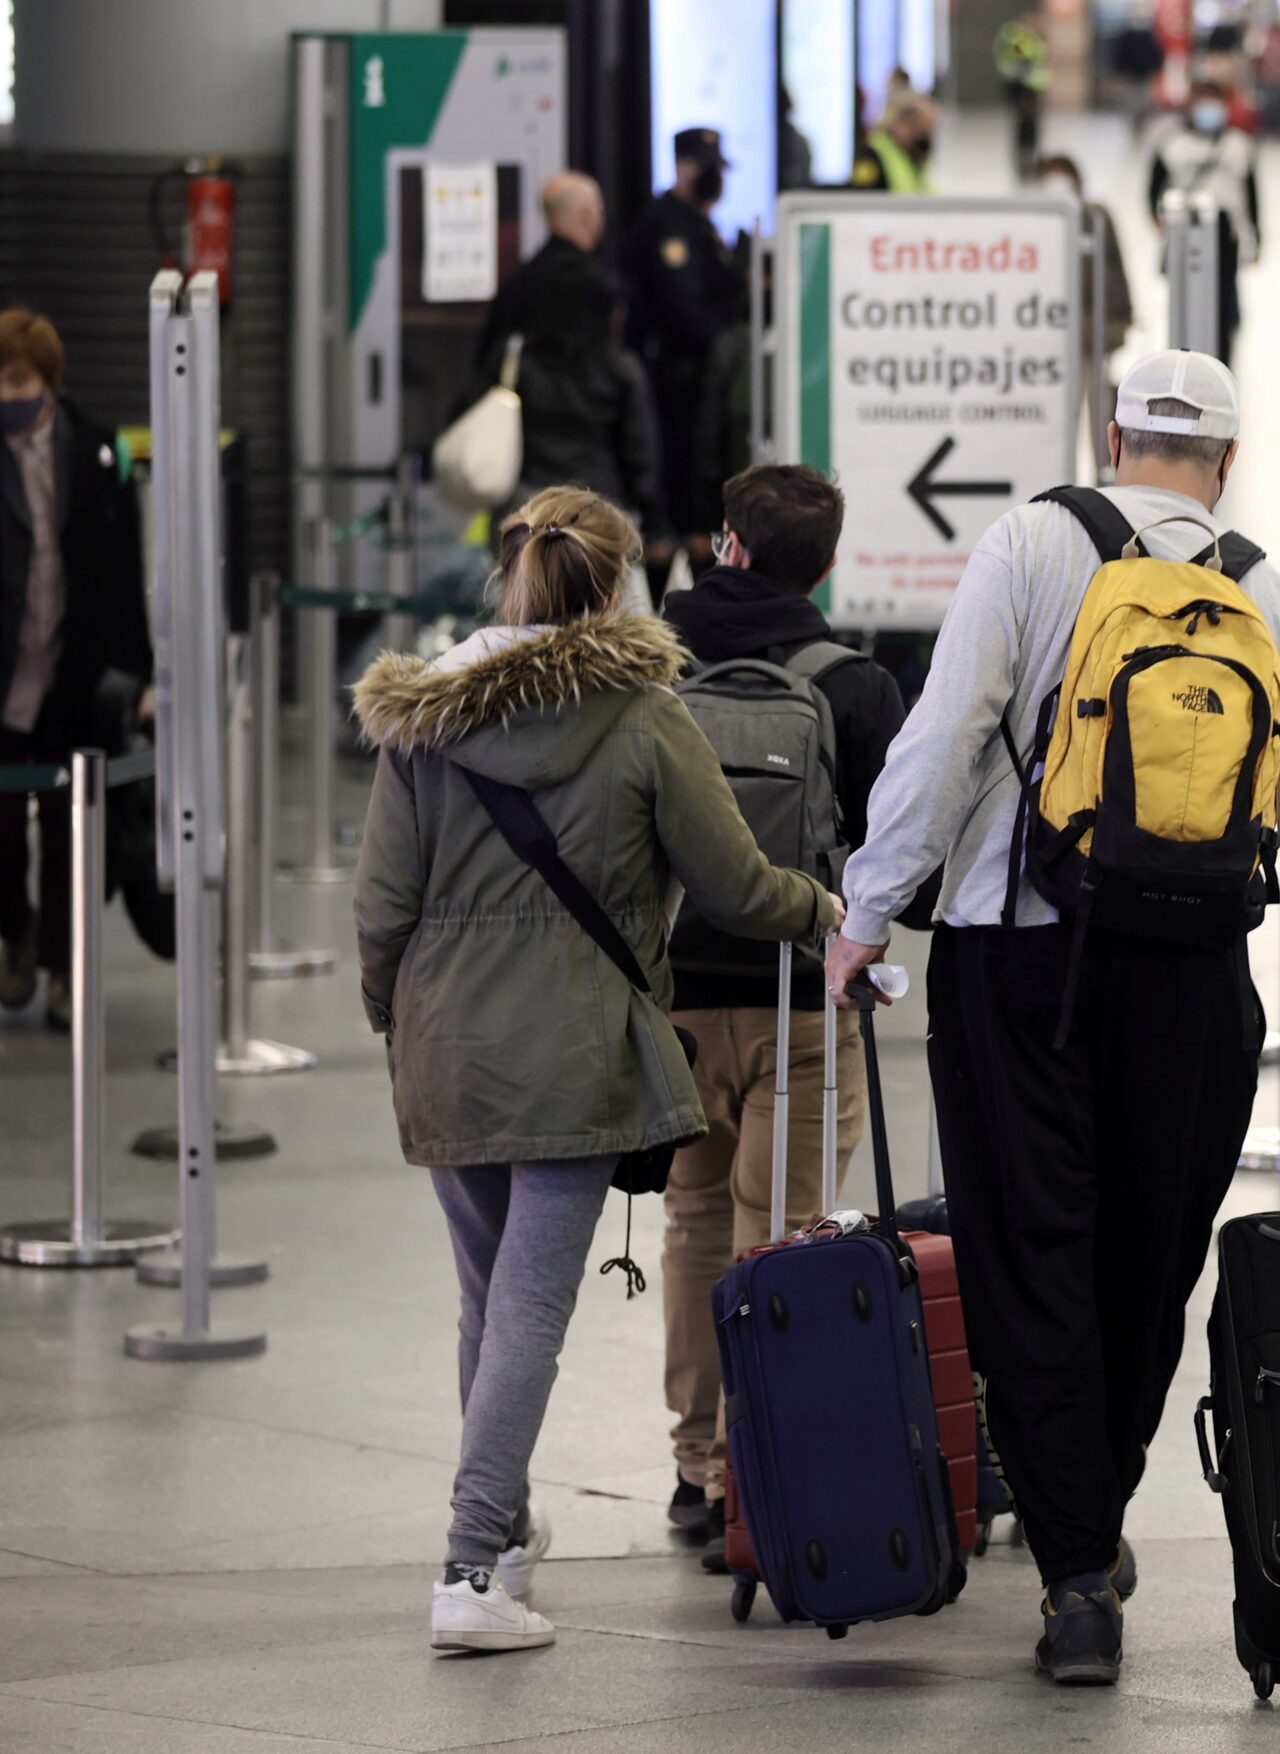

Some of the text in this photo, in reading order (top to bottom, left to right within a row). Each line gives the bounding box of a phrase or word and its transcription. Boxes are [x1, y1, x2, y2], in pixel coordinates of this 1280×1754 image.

[869, 236, 1039, 273] Entrada
[841, 291, 1071, 330] Control de
[848, 347, 1063, 394] equipajes
[1171, 692, 1207, 706] NORTH
[1187, 684, 1207, 697] THE
[1182, 701, 1207, 713] FACE
